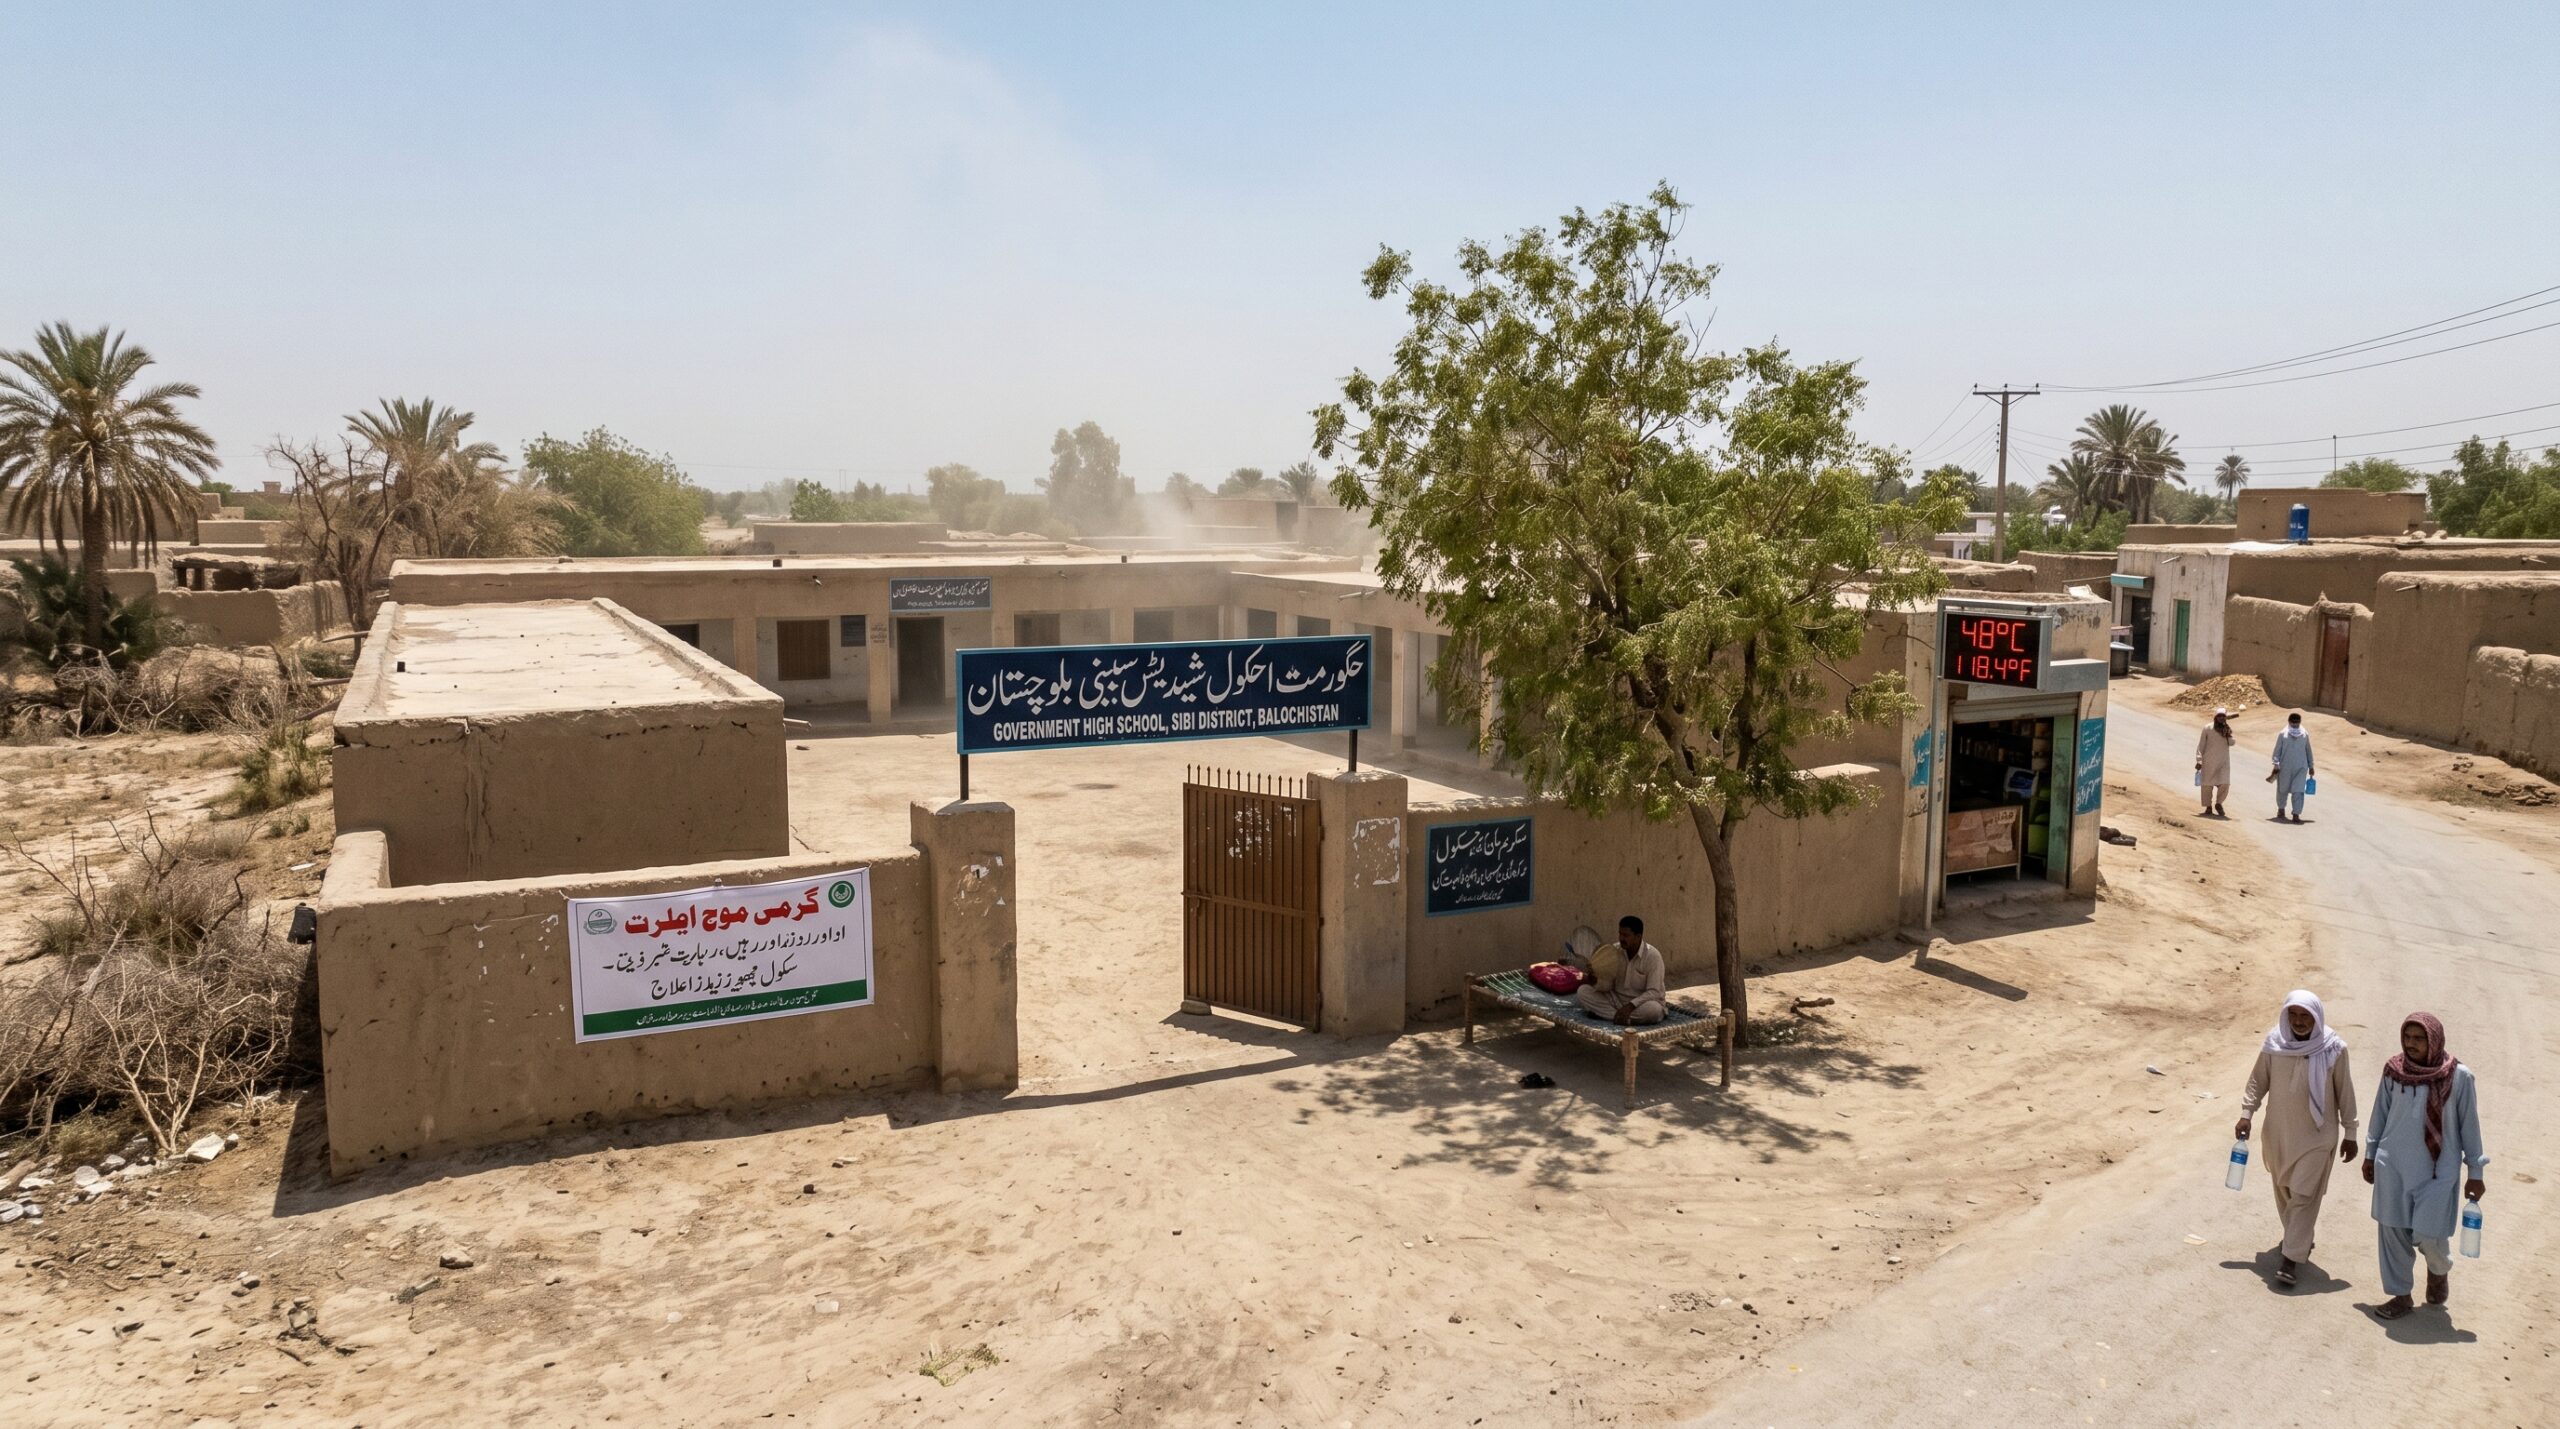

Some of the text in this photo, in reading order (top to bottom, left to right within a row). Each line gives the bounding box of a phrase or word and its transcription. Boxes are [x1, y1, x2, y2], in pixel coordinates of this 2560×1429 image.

[1962, 619, 2026, 652] 48°C
[993, 703, 1339, 741] GOVERNMENT HIGH SCHOOL, SIBI DISTRICT, BALOCHISTAN
[701, 905, 749, 932] موج
[753, 886, 820, 925] گرمی
[760, 953, 798, 987] سکول
